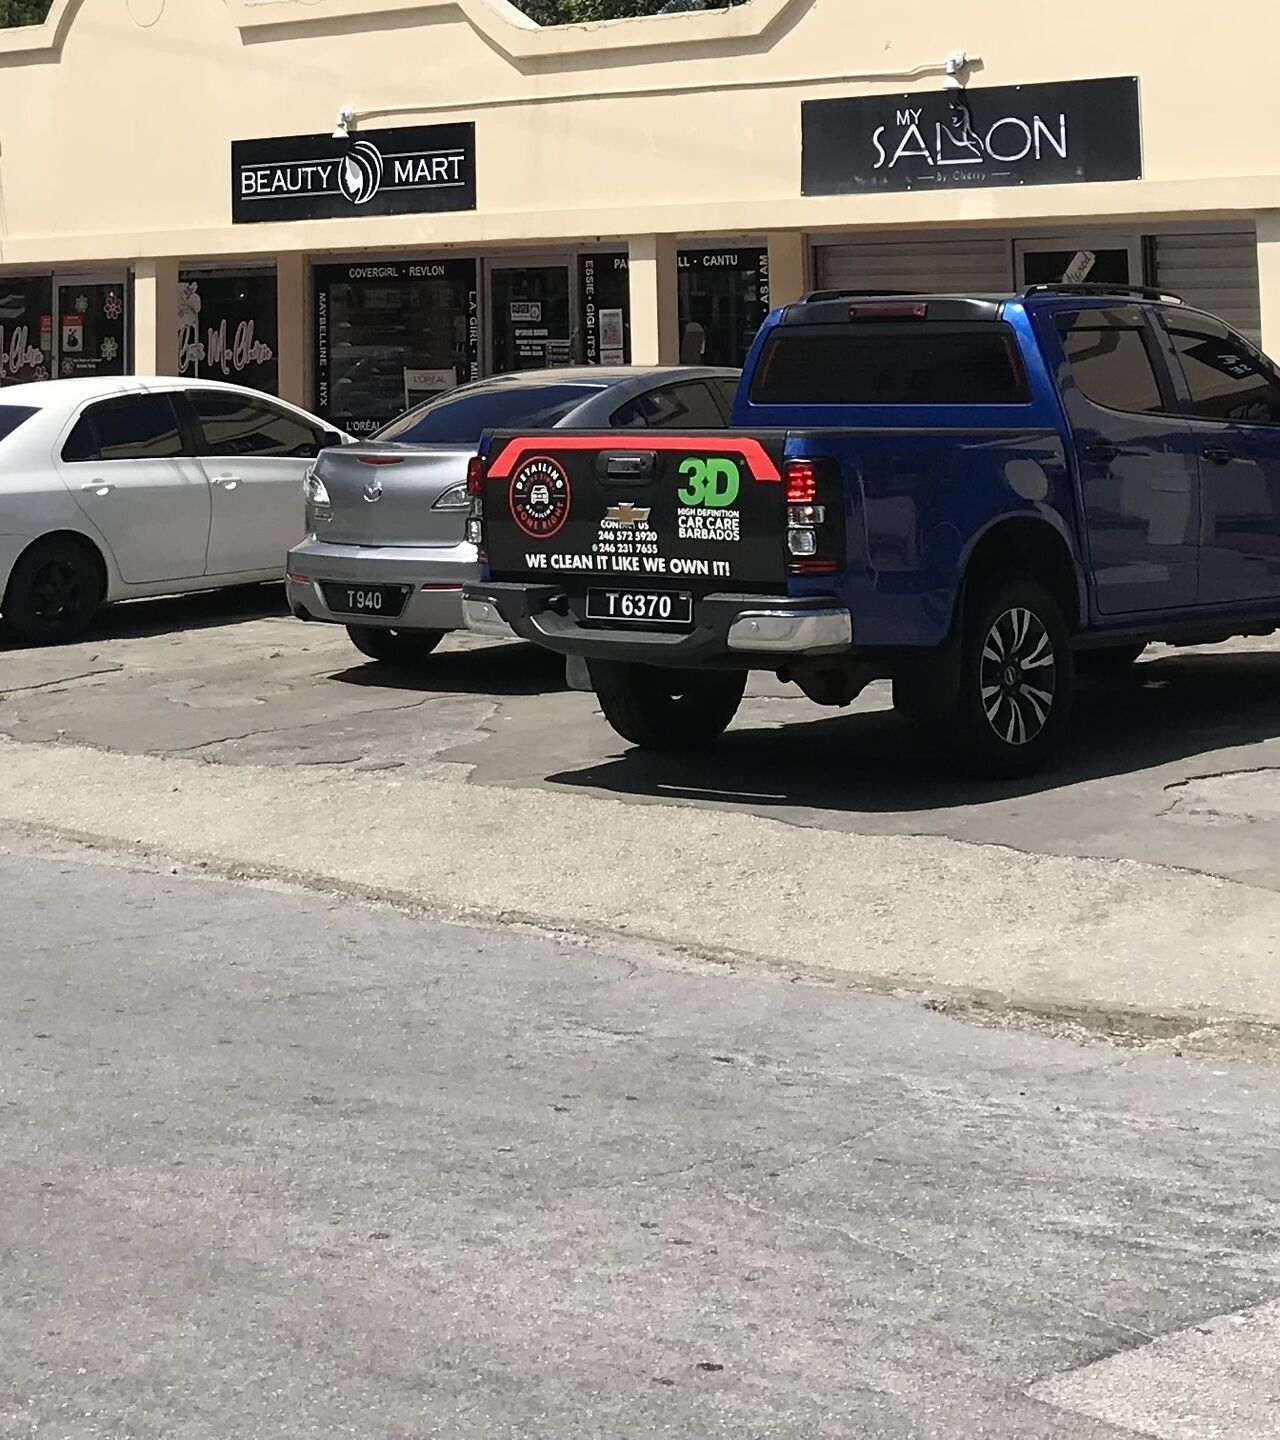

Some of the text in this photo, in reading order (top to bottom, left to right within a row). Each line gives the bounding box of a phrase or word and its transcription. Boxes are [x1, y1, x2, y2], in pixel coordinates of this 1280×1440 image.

[896, 108, 922, 127] MY
[873, 113, 1067, 169] SALON
[241, 156, 465, 195] BEAUTY MART
[349, 265, 445, 279] COVERGIRL REVLON
[614, 258, 627, 270] PA
[703, 254, 738, 267] CANTU
[759, 255, 768, 275] AM
[586, 260, 595, 294] ESSIE
[760, 286, 769, 303] AS
[586, 303, 595, 328] GIGI
[469, 317, 478, 346] GIRL
[319, 292, 328, 406] MAYBELLINE NYX
[516, 462, 564, 490] DETAILING
[677, 457, 740, 507] 3D
[677, 507, 740, 518] HIGH DEFINITION
[678, 516, 740, 531] CAR CARE
[598, 530, 658, 541] 246 572 5920
[678, 528, 740, 541] BARBADOS
[599, 542, 658, 554] 246 231 7655
[525, 554, 730, 577] WE CLEAN IT LIKE WE OWN IT!
